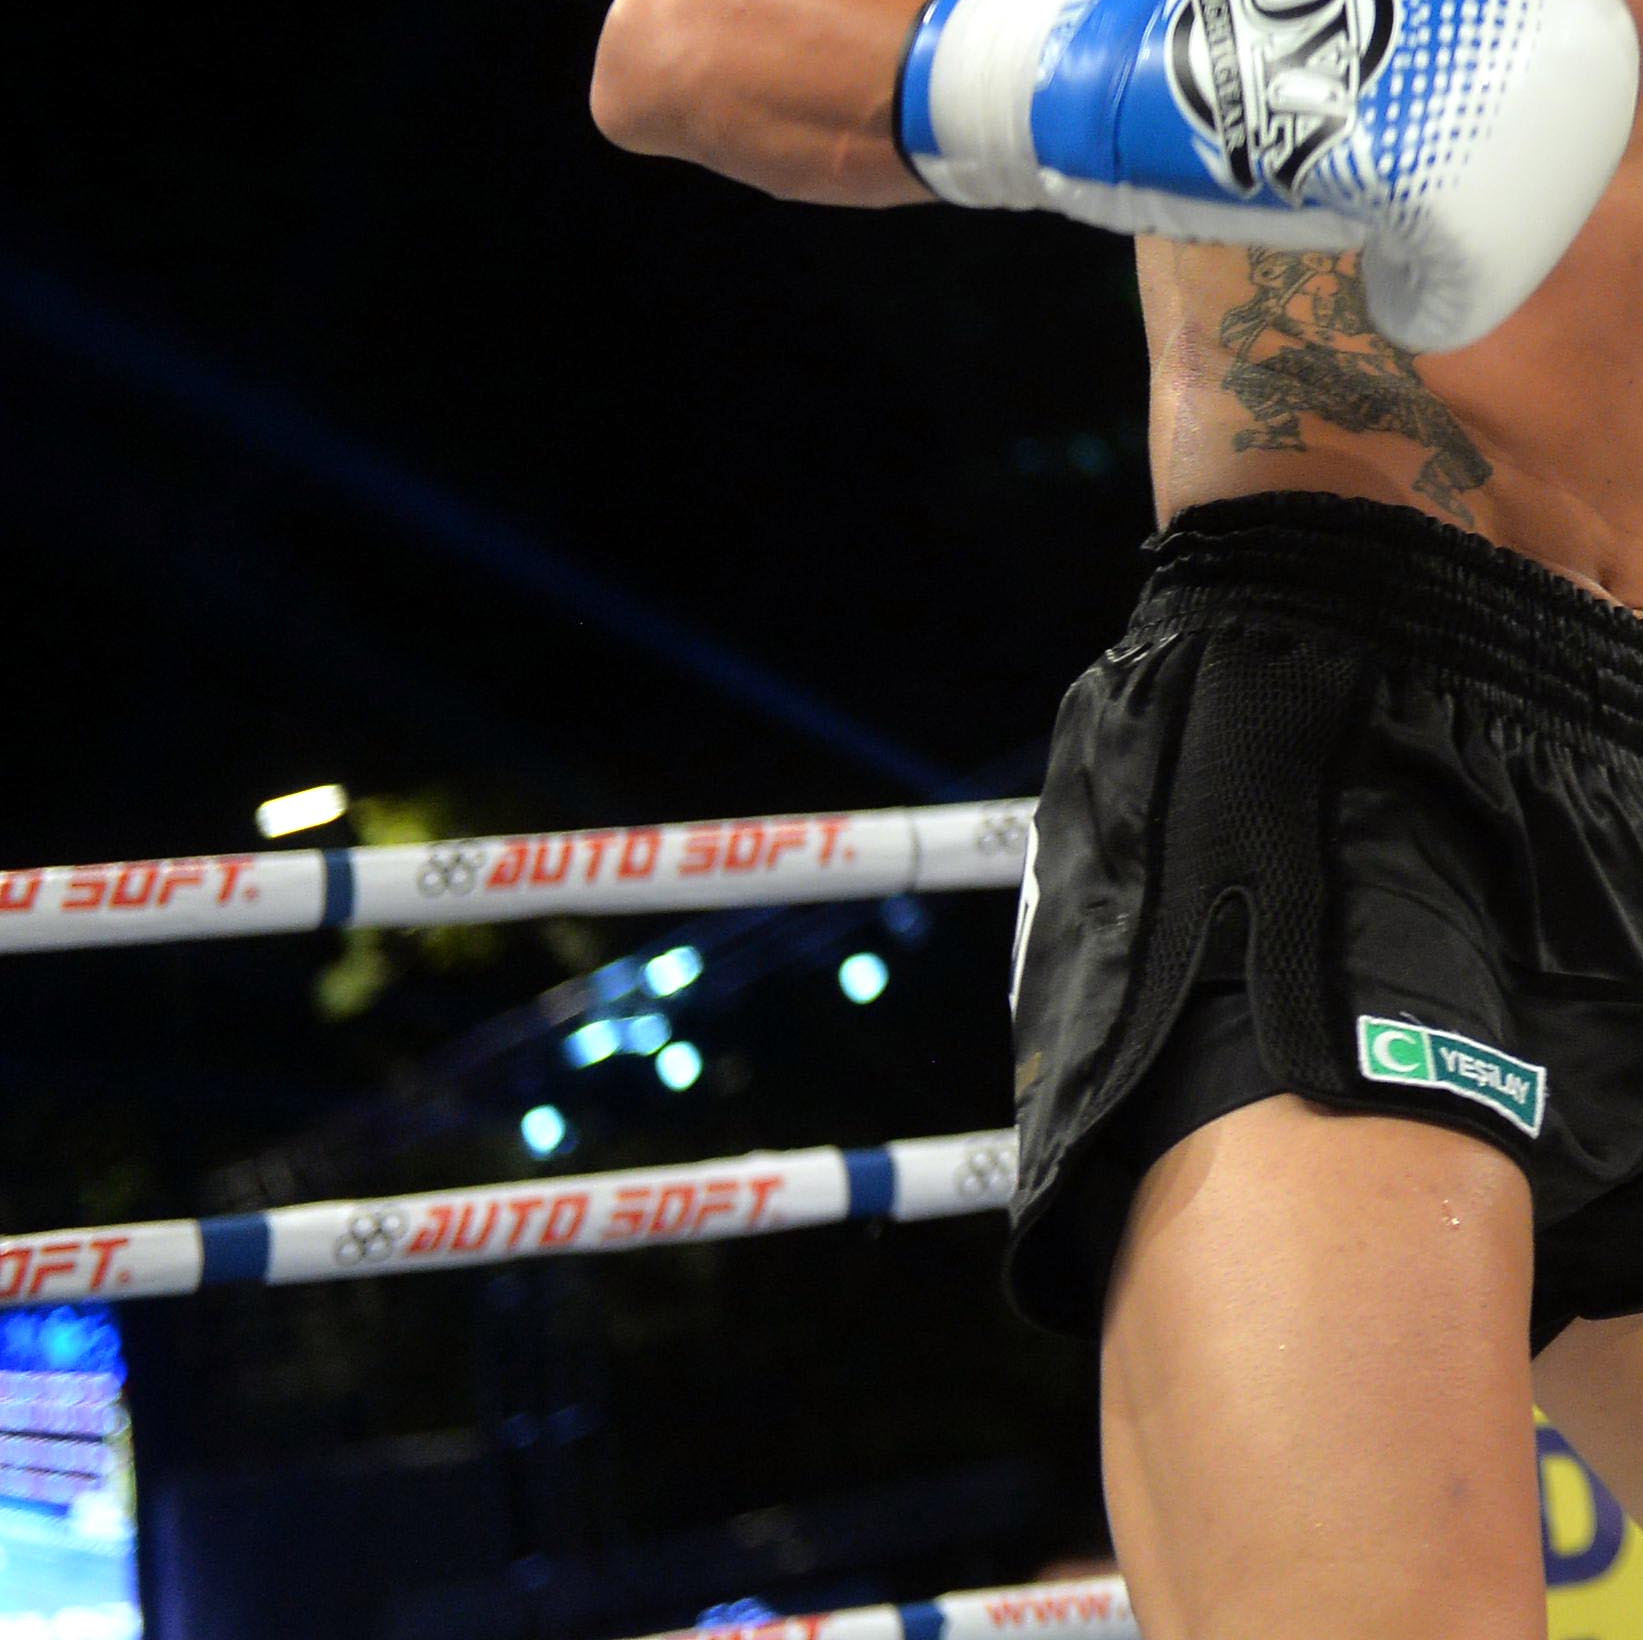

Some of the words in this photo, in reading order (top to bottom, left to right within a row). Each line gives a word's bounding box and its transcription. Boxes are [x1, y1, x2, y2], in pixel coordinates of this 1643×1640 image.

[485, 826, 663, 891] AUTO
[405, 1190, 593, 1257] AUTO
[0, 1236, 131, 1300] OFT
